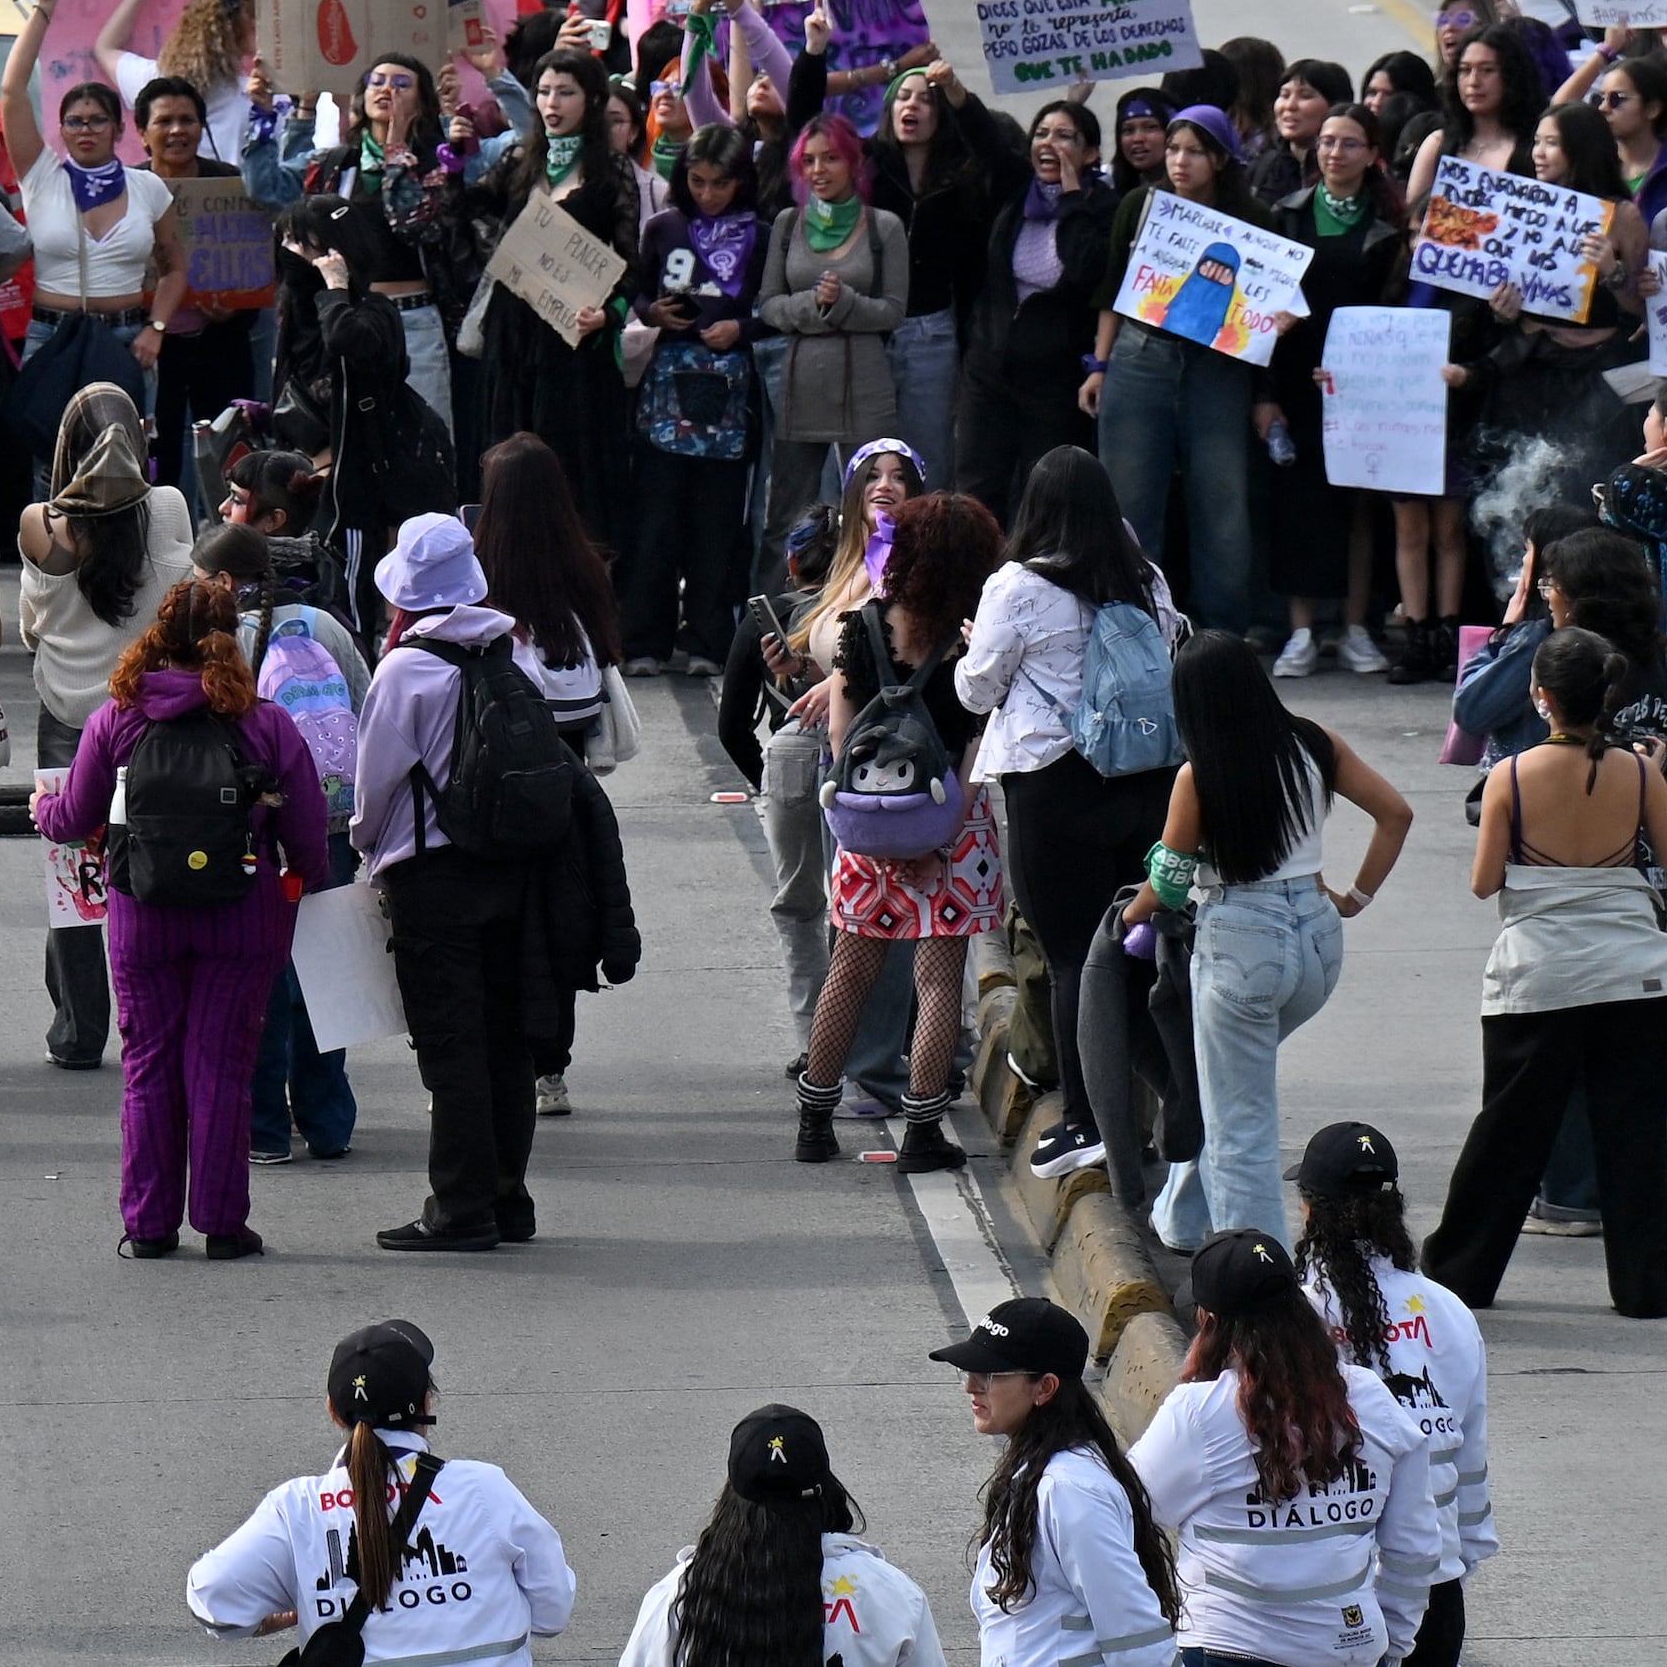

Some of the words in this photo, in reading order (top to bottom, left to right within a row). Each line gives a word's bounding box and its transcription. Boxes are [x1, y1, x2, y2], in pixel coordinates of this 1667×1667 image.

[977, 1, 1018, 20] DICES
[983, 41, 1018, 60] PERO
[1022, 34, 1067, 55] GOZAS
[1073, 31, 1091, 48] DE
[1093, 27, 1117, 44] LOS
[1120, 18, 1186, 41] DERECHOS
[988, 22, 1014, 38] no
[1014, 60, 1055, 82] QUE
[1056, 55, 1084, 76] TE
[1564, 194, 1578, 215] A
[1149, 221, 1164, 240] TE
[1168, 232, 1200, 255] FALTE
[1503, 223, 1518, 240] Y
[1522, 230, 1542, 245] NO
[1551, 237, 1567, 252] A
[1554, 217, 1566, 232] A
[534, 205, 555, 228] TU
[563, 232, 608, 280] PLACER
[1285, 249, 1304, 261] NO
[538, 252, 554, 271] NO
[1139, 245, 1147, 254] A
[1244, 283, 1270, 303] LES
[1132, 264, 1174, 296] FALTA
[1231, 303, 1275, 334] TODO
[1521, 271, 1572, 307] VIVAS
[1246, 1497, 1375, 1530] DIÁLOGO
